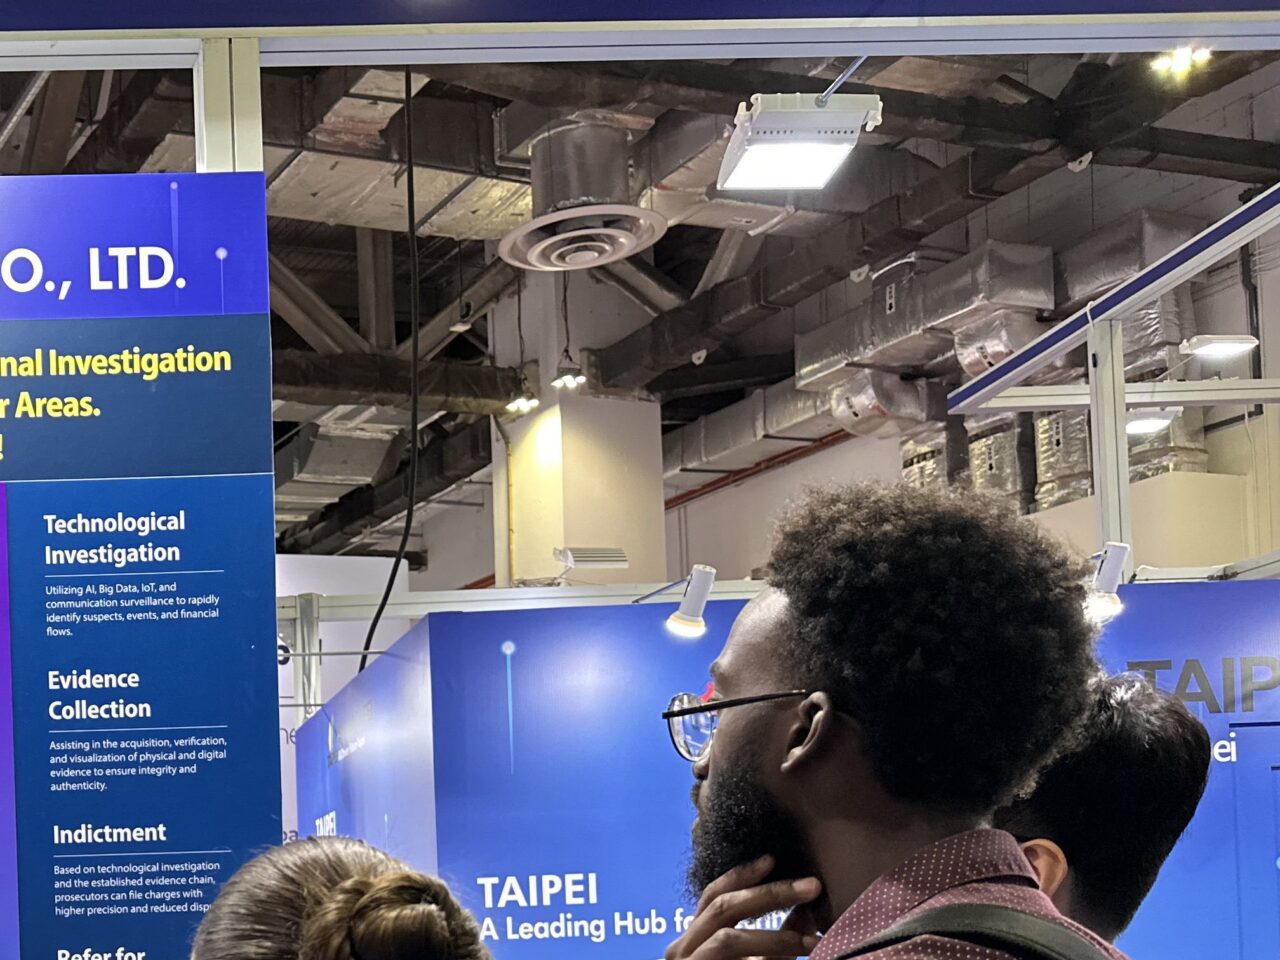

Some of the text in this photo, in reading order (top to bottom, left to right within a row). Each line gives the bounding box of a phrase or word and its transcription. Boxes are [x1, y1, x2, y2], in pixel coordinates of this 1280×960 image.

[89, 245, 186, 291] LTD.
[49, 346, 231, 377] Investigation
[15, 389, 100, 419] Areas.
[44, 511, 185, 536] Technological
[45, 544, 180, 567] Investigation
[46, 585, 83, 596] Utilizing
[99, 583, 114, 595] Big
[116, 583, 139, 594] Data,
[159, 582, 176, 592] and
[46, 595, 219, 609] communication surveillance to rapidly
[46, 608, 219, 623] identify suspects, events, and financial
[47, 626, 73, 636] flows.
[48, 670, 140, 690] Evidence
[1127, 657, 1280, 713] TAIP
[48, 699, 151, 720] Collection
[50, 736, 227, 750] Assisting in the acquisition, verification,
[1212, 732, 1237, 762] ei
[50, 749, 227, 764] and visualization of physical and digital
[50, 764, 196, 777] evidence to ensure integrity and
[50, 780, 107, 791] authenticity.
[53, 824, 166, 844] Indictment
[54, 861, 220, 875] Based on technological investigation
[54, 874, 216, 888] and the established evidence chain,
[55, 888, 202, 903] prosecutors can file charges with
[477, 873, 597, 909] TAIPEI
[56, 902, 212, 918] higher precision and reduced disp
[479, 910, 666, 943] A Leading Hub
